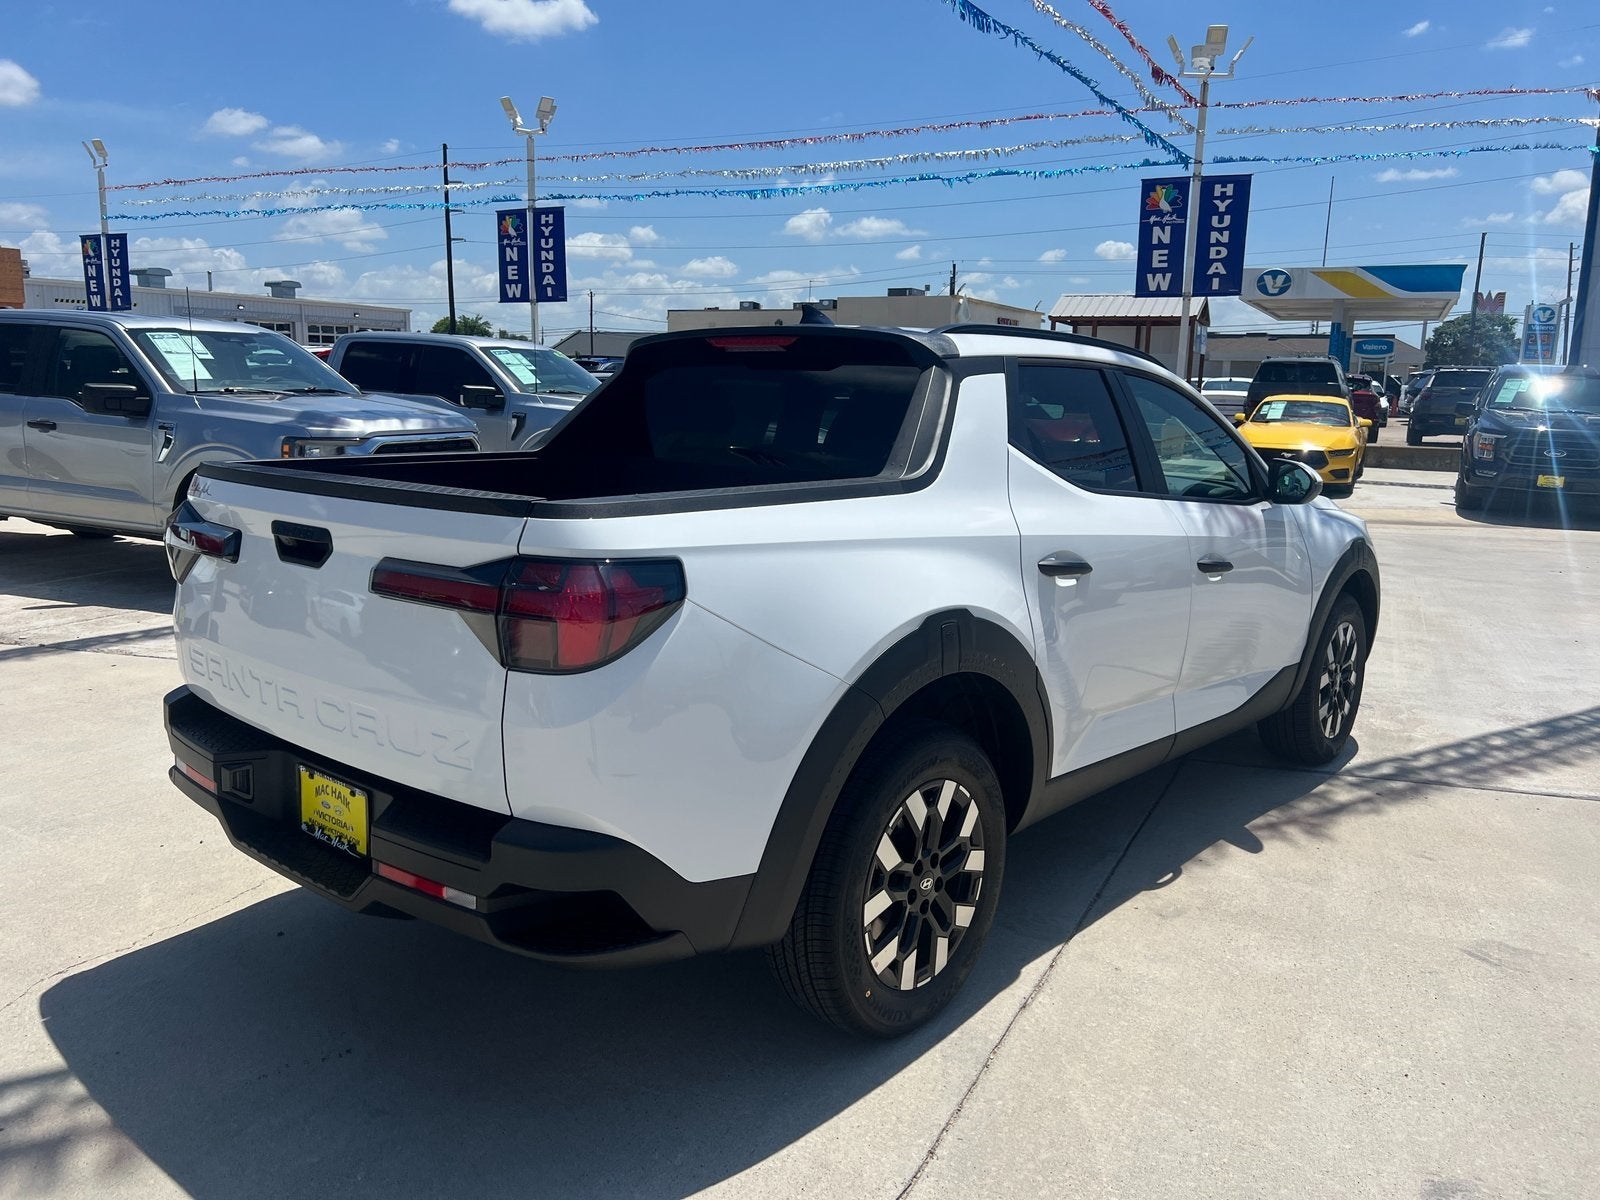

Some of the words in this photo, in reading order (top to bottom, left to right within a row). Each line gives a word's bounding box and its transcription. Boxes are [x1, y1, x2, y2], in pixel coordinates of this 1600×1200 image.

[540, 214, 556, 297] HYUNDAI
[1146, 226, 1172, 292] NEW
[1206, 183, 1234, 290] HYUNDAI
[87, 265, 101, 307] NEW
[111, 239, 123, 306] HYUNDAI
[505, 247, 522, 298] NEW
[1362, 343, 1388, 351] Valero
[189, 645, 304, 720] SANTA
[314, 696, 473, 772] CRUZ
[314, 784, 330, 798] MAC
